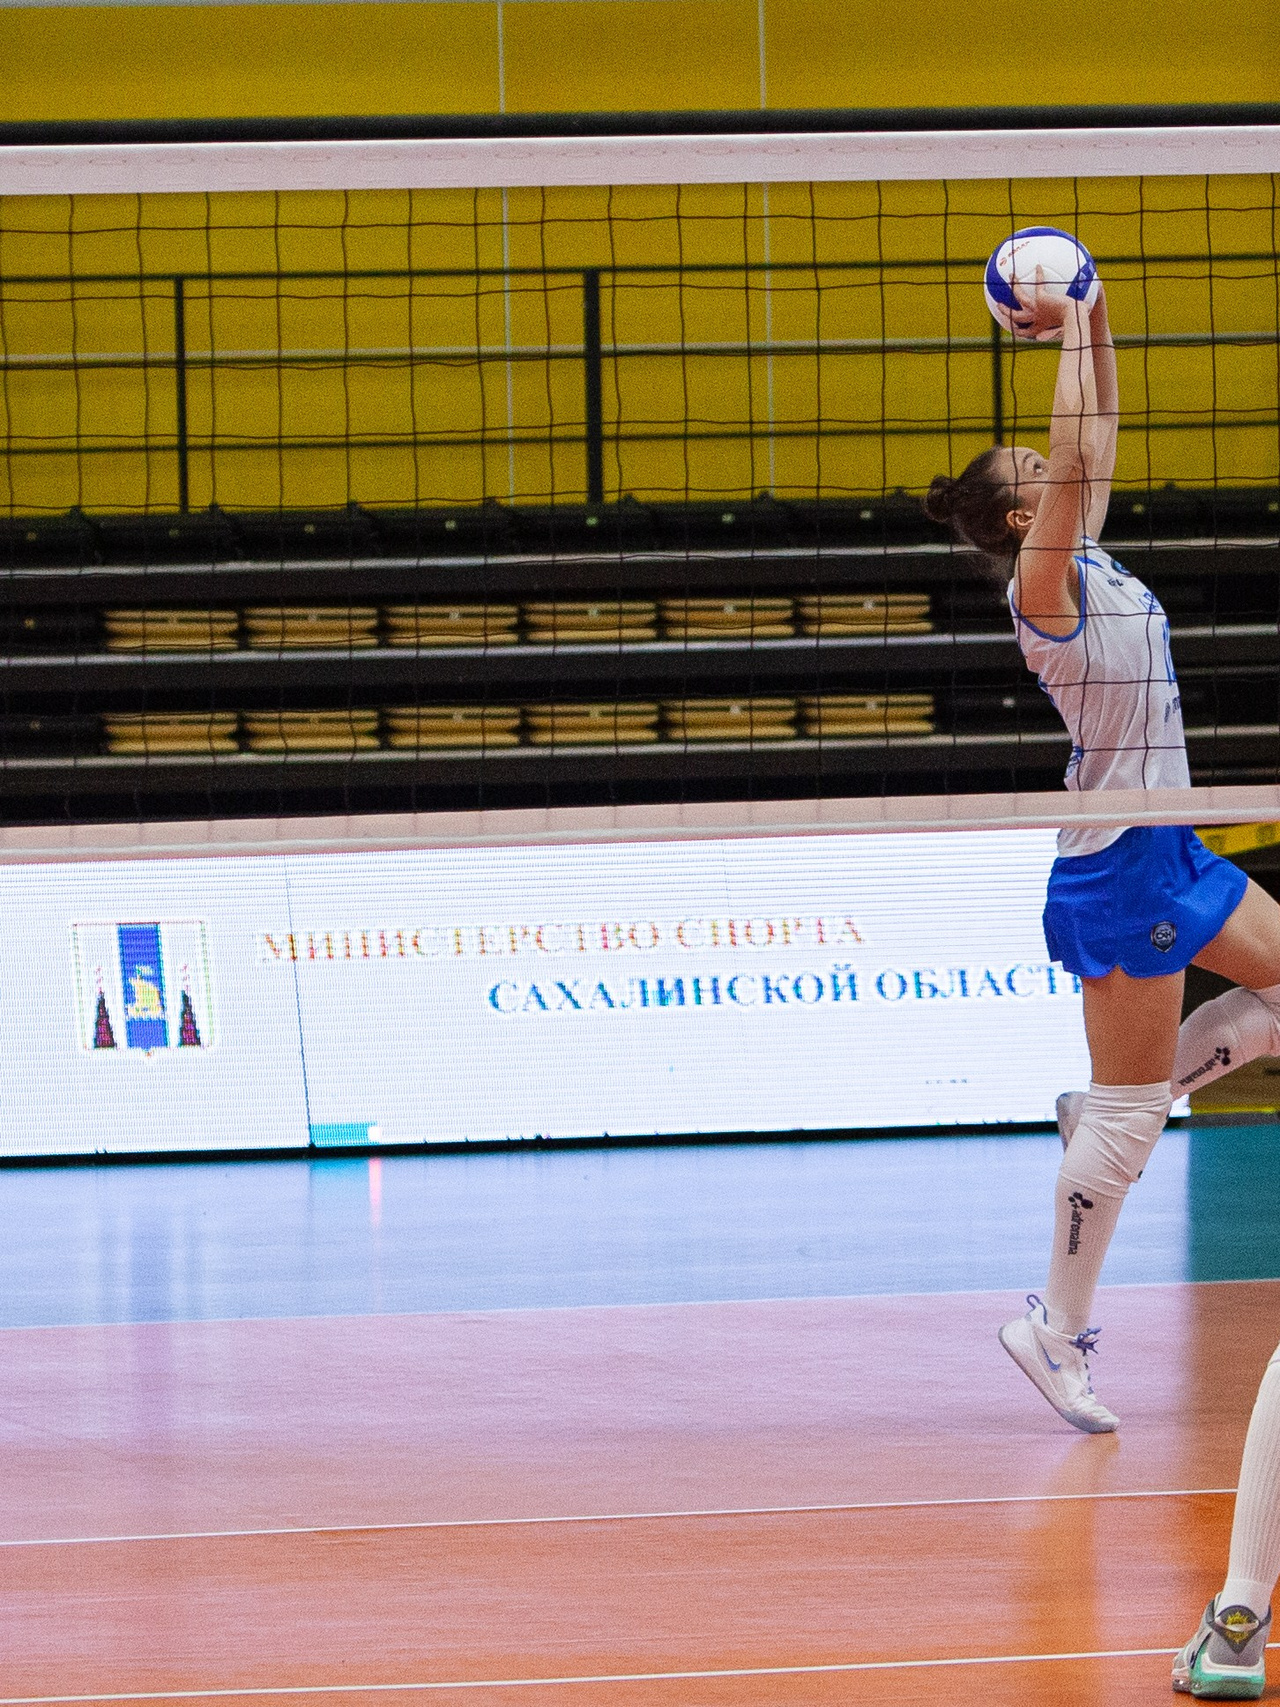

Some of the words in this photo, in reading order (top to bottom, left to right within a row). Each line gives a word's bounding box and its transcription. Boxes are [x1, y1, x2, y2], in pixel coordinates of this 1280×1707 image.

[262, 921, 660, 963] МИНИСТЕРСТВО
[676, 914, 865, 949] СПОРТА
[488, 963, 859, 1014] САХАЛИНСКОЙ
